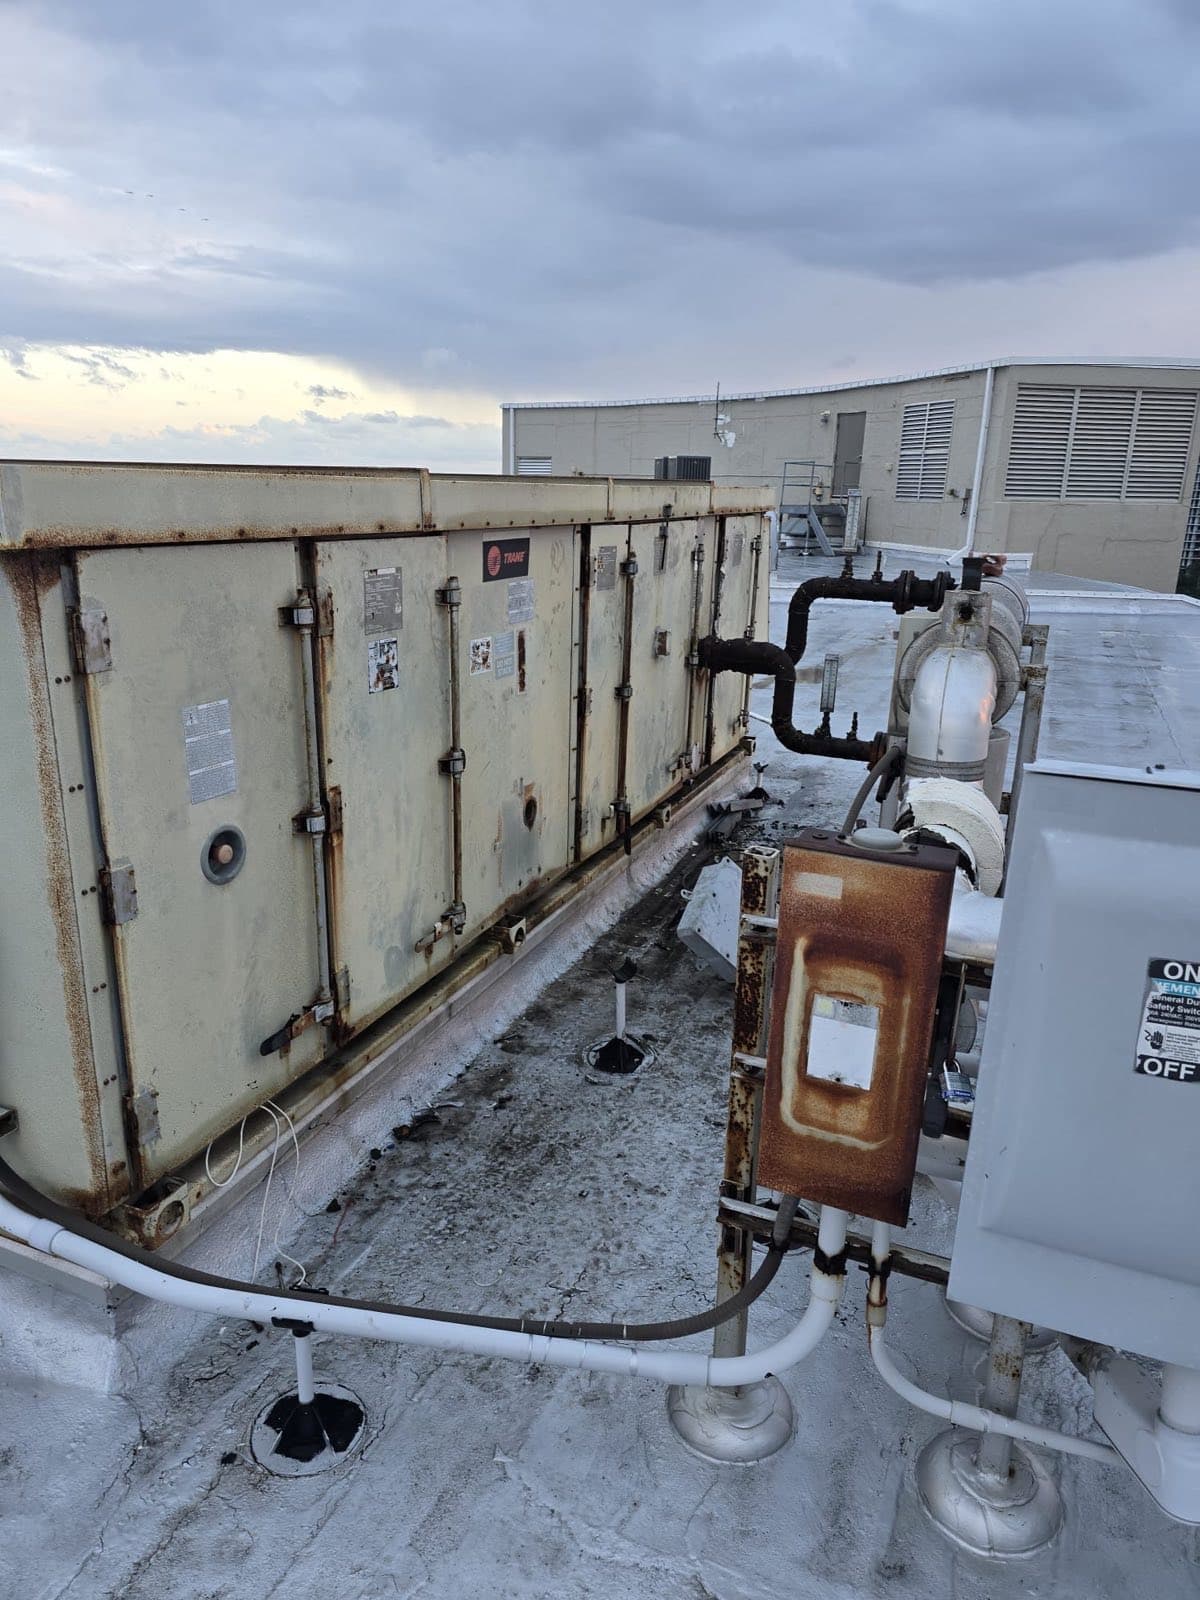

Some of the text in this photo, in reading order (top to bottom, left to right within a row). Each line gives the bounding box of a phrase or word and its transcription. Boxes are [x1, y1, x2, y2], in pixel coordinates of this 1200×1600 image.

[504, 551, 525, 565] TRANE
[1163, 961, 1200, 983] ON
[1143, 1057, 1196, 1080] OFF
